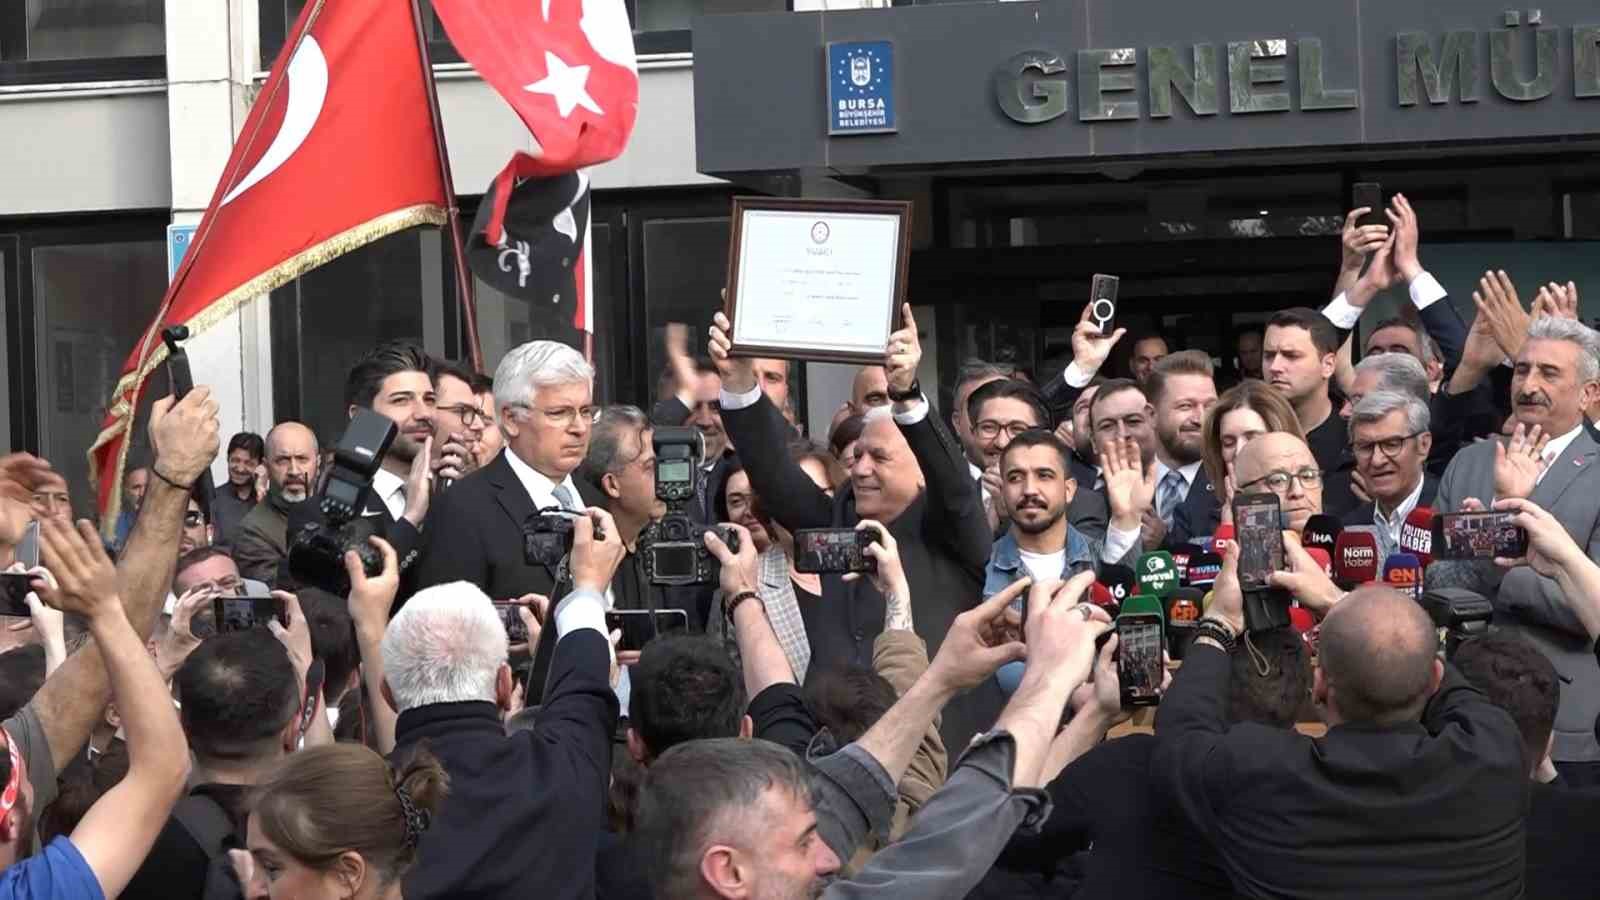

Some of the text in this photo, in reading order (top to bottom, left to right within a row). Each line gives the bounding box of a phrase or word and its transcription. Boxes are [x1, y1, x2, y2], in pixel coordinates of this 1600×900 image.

[997, 38, 1358, 122] GENEL
[838, 98, 885, 110] BURSA
[1343, 548, 1374, 558] Norm
